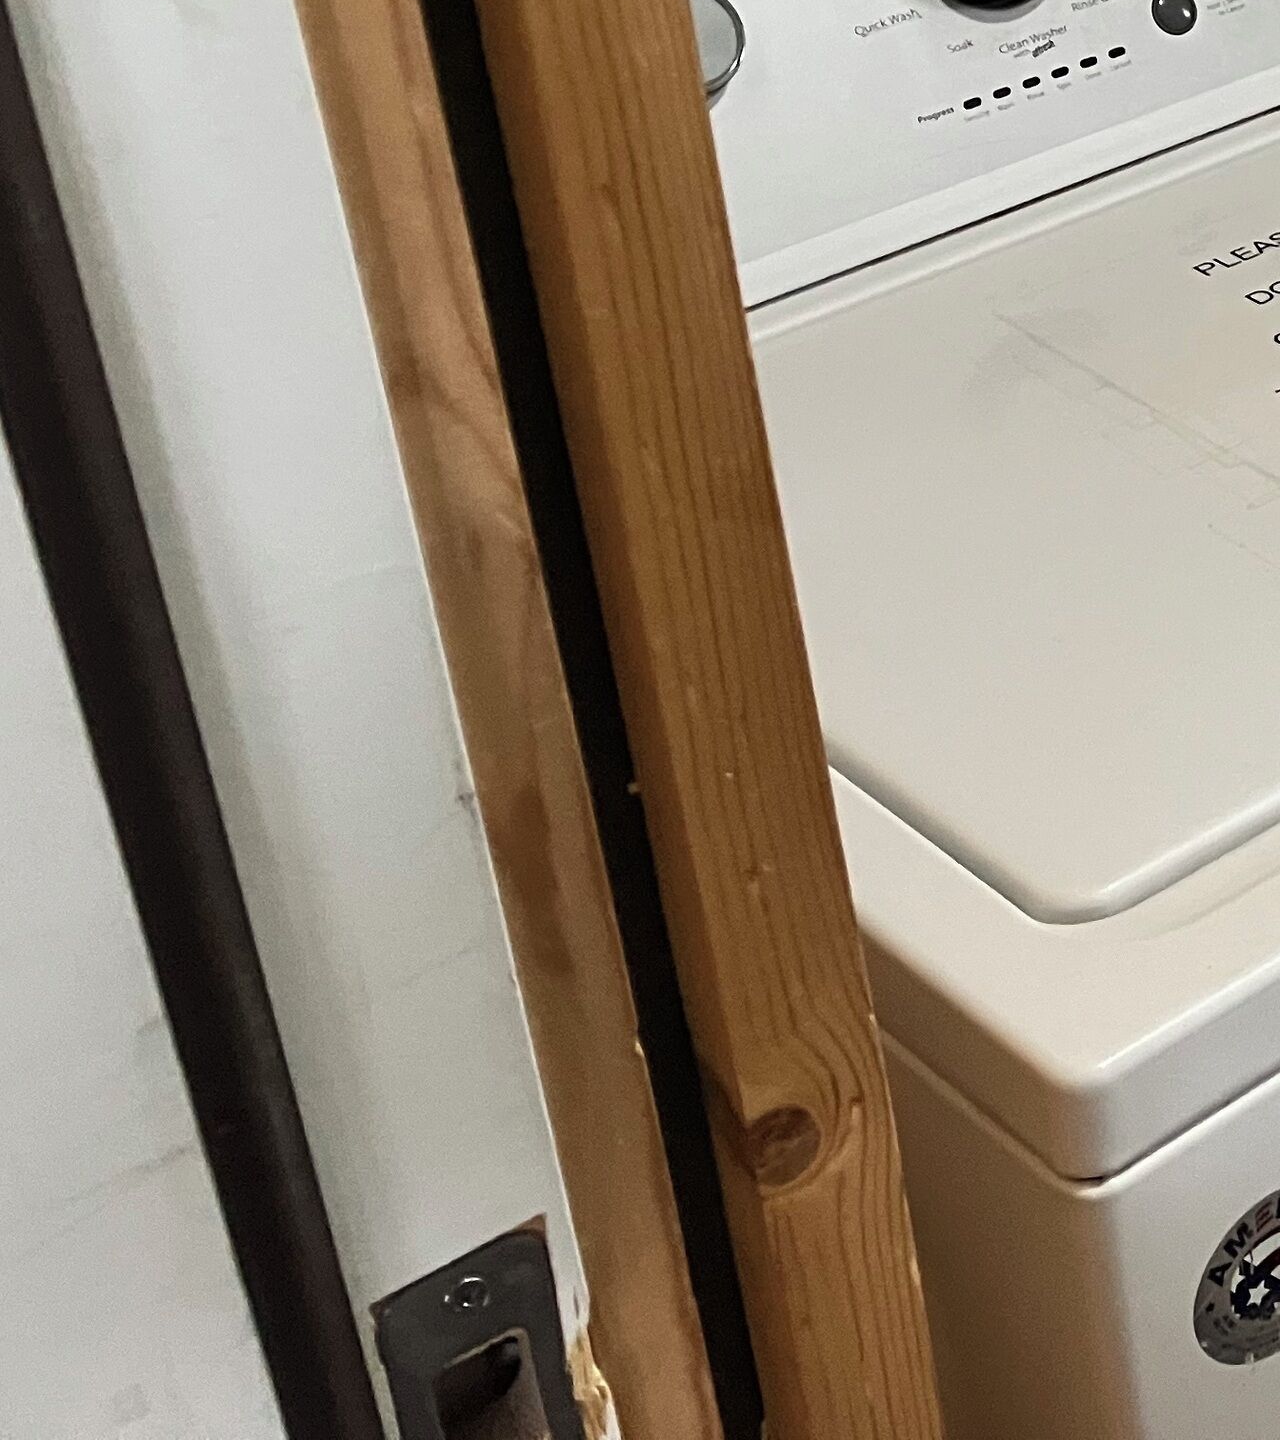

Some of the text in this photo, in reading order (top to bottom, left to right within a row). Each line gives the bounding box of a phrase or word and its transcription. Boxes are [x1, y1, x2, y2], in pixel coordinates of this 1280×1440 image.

[854, 7, 923, 38] Quick Wash
[946, 39, 975, 53] Soak
[998, 38, 1031, 54] Clean
[1028, 24, 1068, 44] Washer
